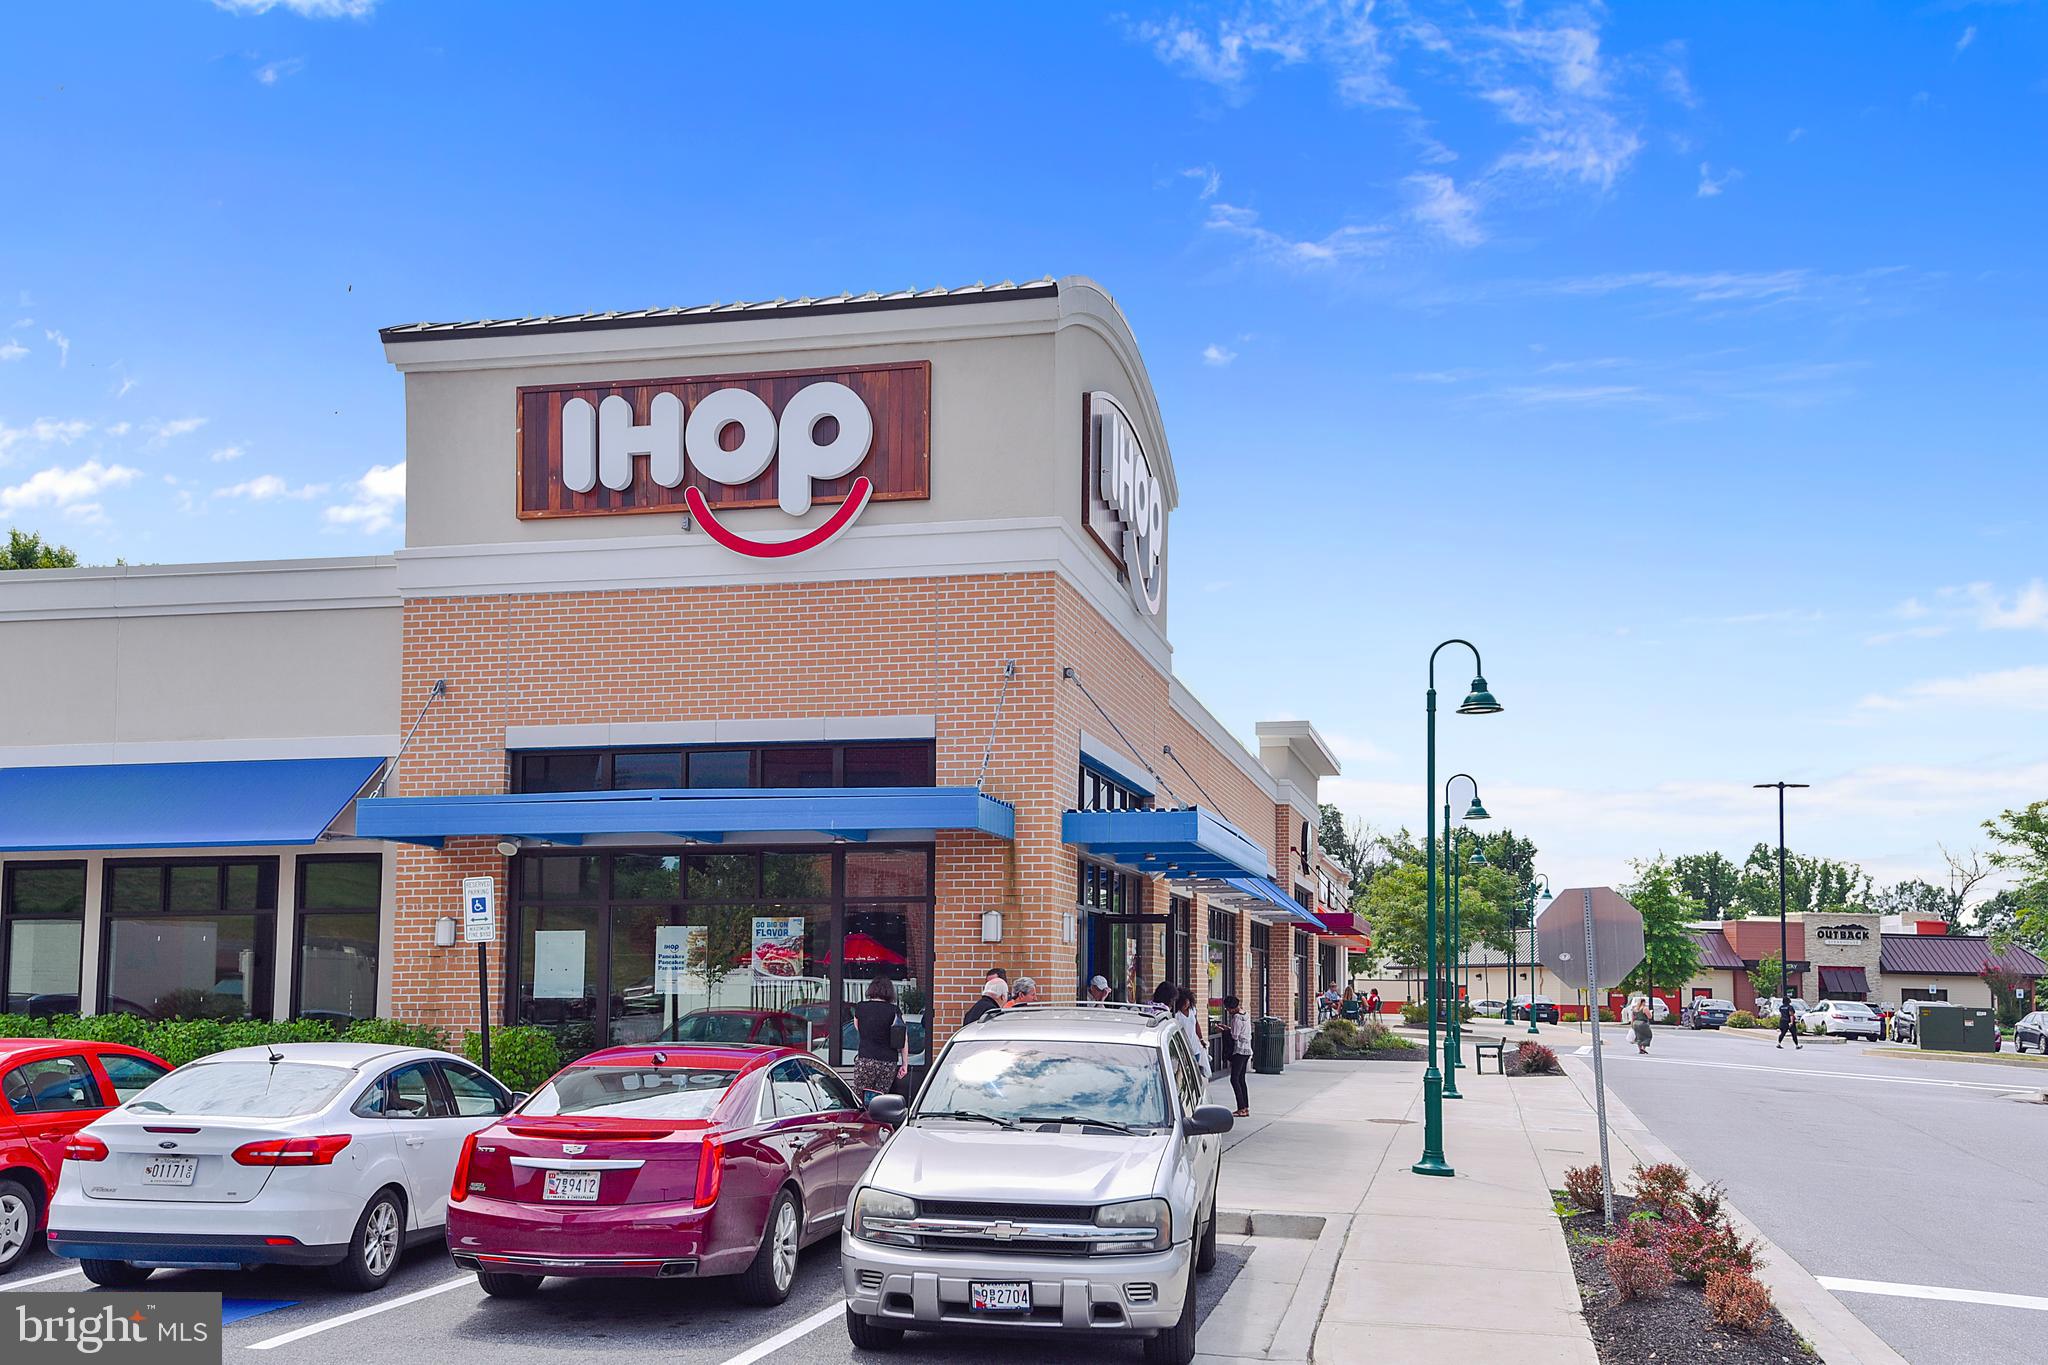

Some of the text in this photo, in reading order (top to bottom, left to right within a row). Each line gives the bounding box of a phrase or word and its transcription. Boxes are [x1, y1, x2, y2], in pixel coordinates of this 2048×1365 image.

[562, 381, 873, 516] IHOP
[1101, 413, 1163, 579] IHOP
[1817, 930, 1869, 940] OUTBACK
